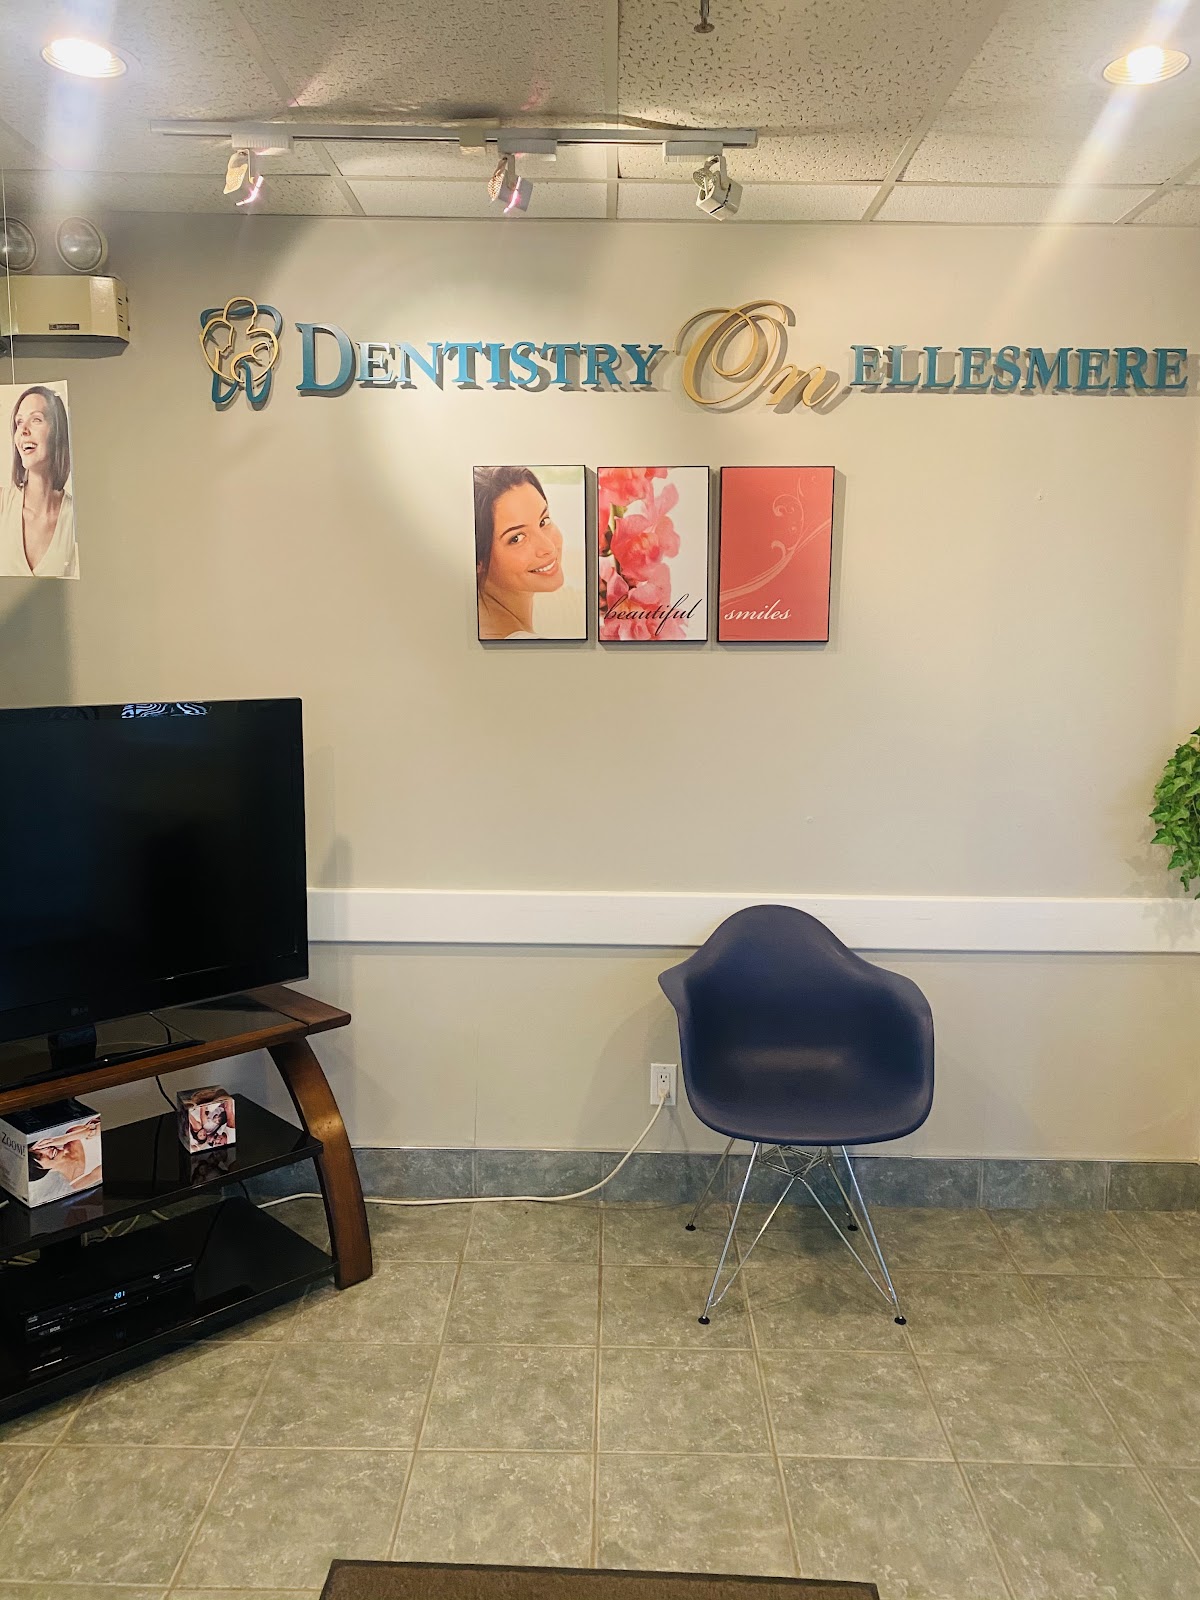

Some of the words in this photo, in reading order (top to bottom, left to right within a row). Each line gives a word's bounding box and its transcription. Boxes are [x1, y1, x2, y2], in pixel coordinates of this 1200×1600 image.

[295, 322, 664, 392] DENTISTRY
[673, 300, 839, 407] On
[850, 345, 1188, 390] ELLESMERE
[603, 593, 703, 636] beautiful
[723, 599, 792, 621] smiles
